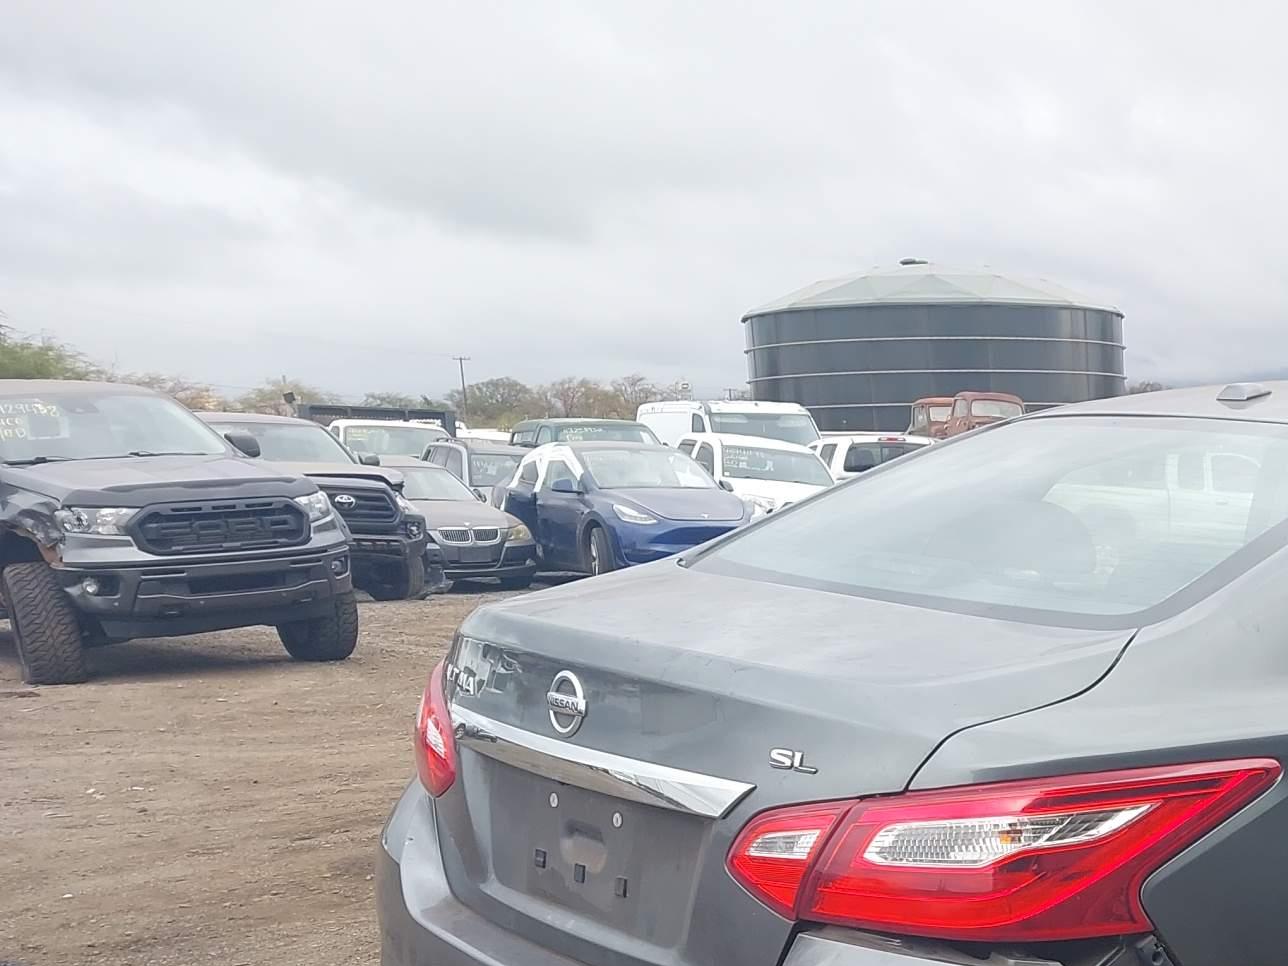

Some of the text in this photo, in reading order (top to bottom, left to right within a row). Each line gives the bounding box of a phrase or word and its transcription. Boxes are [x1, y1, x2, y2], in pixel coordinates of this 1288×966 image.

[145, 514, 296, 550] FORD
[546, 695, 579, 710] NISSAN
[769, 747, 818, 775] SL
